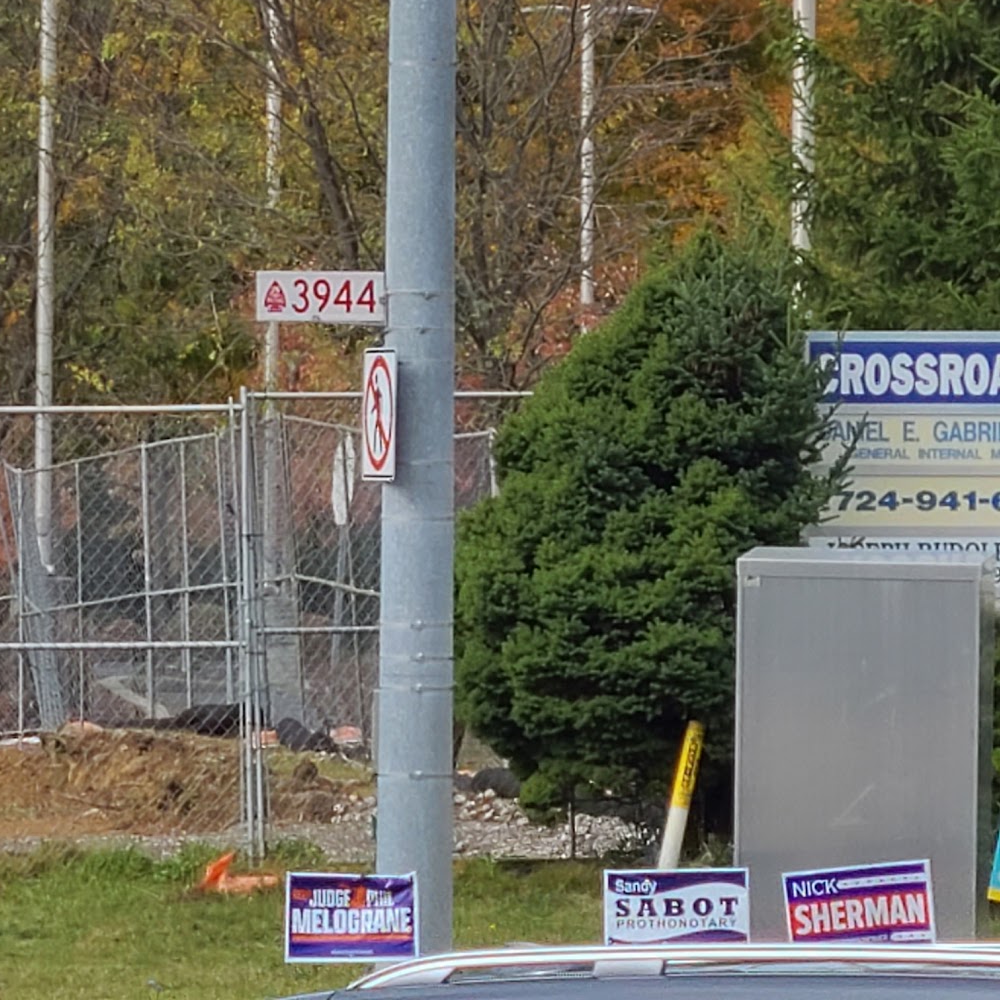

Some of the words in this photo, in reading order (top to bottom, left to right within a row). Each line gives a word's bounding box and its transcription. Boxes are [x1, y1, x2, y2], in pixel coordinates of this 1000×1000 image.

[292, 279, 376, 313] 3944
[825, 420, 890, 441] ANEL
[903, 421, 919, 442] E.
[933, 420, 1000, 443] GABRI
[918, 448, 982, 460] INTERNAL
[615, 879, 657, 894] Sandy
[792, 878, 840, 898] NICK
[309, 889, 351, 907] JUDGE
[615, 897, 738, 917] SABOT
[291, 907, 412, 934] MELOGRANE
[616, 917, 737, 929] PROTHONOTARY
[793, 893, 926, 935] SHERMAN
